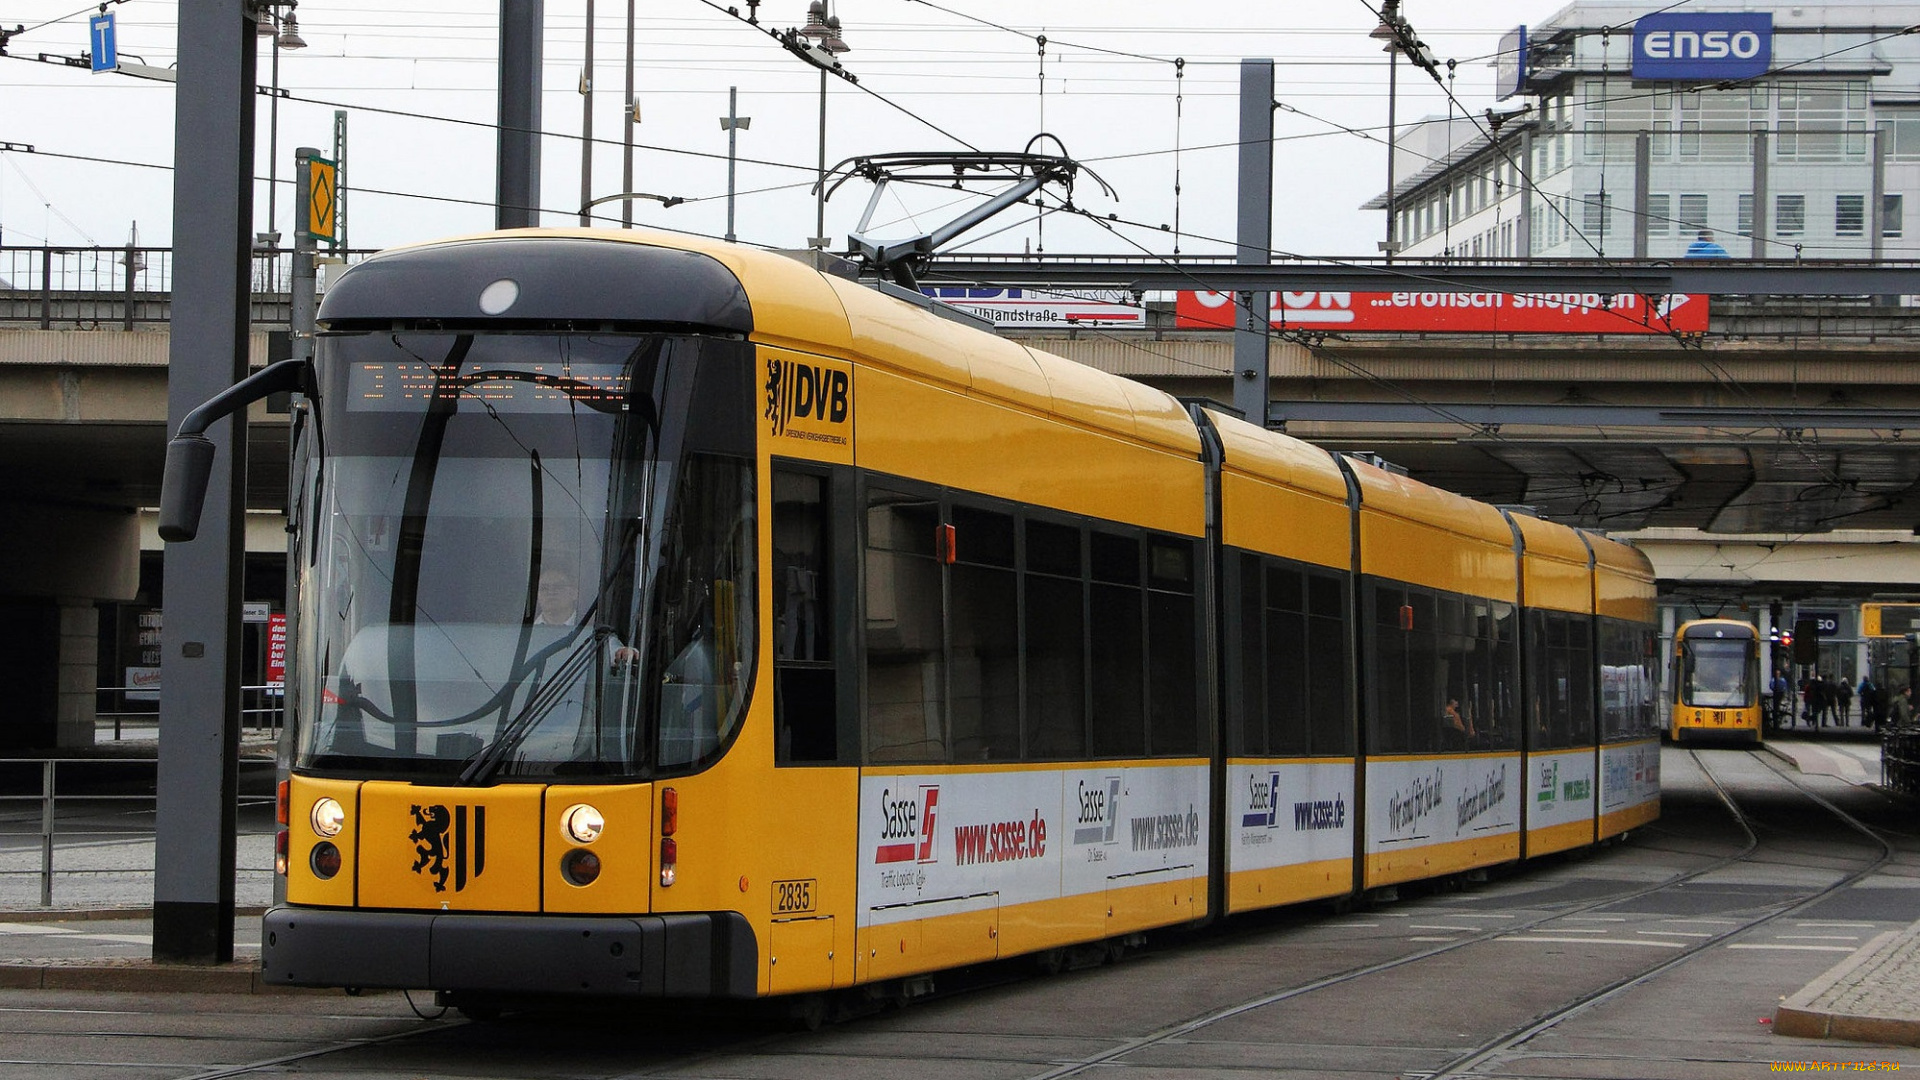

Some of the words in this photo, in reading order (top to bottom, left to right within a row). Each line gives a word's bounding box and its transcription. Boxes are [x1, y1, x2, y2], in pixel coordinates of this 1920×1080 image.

[794, 363, 849, 424] DVB
[1818, 619, 1836, 630] SO
[881, 788, 917, 839] Sasse
[1078, 779, 1104, 823] Sasse
[1249, 773, 1268, 810] Sasse
[1294, 792, 1345, 832] www.sasse.de
[954, 808, 1047, 866] www.sasse.de
[1131, 803, 1199, 852] www.sasse.de
[778, 882, 810, 911] 2835
